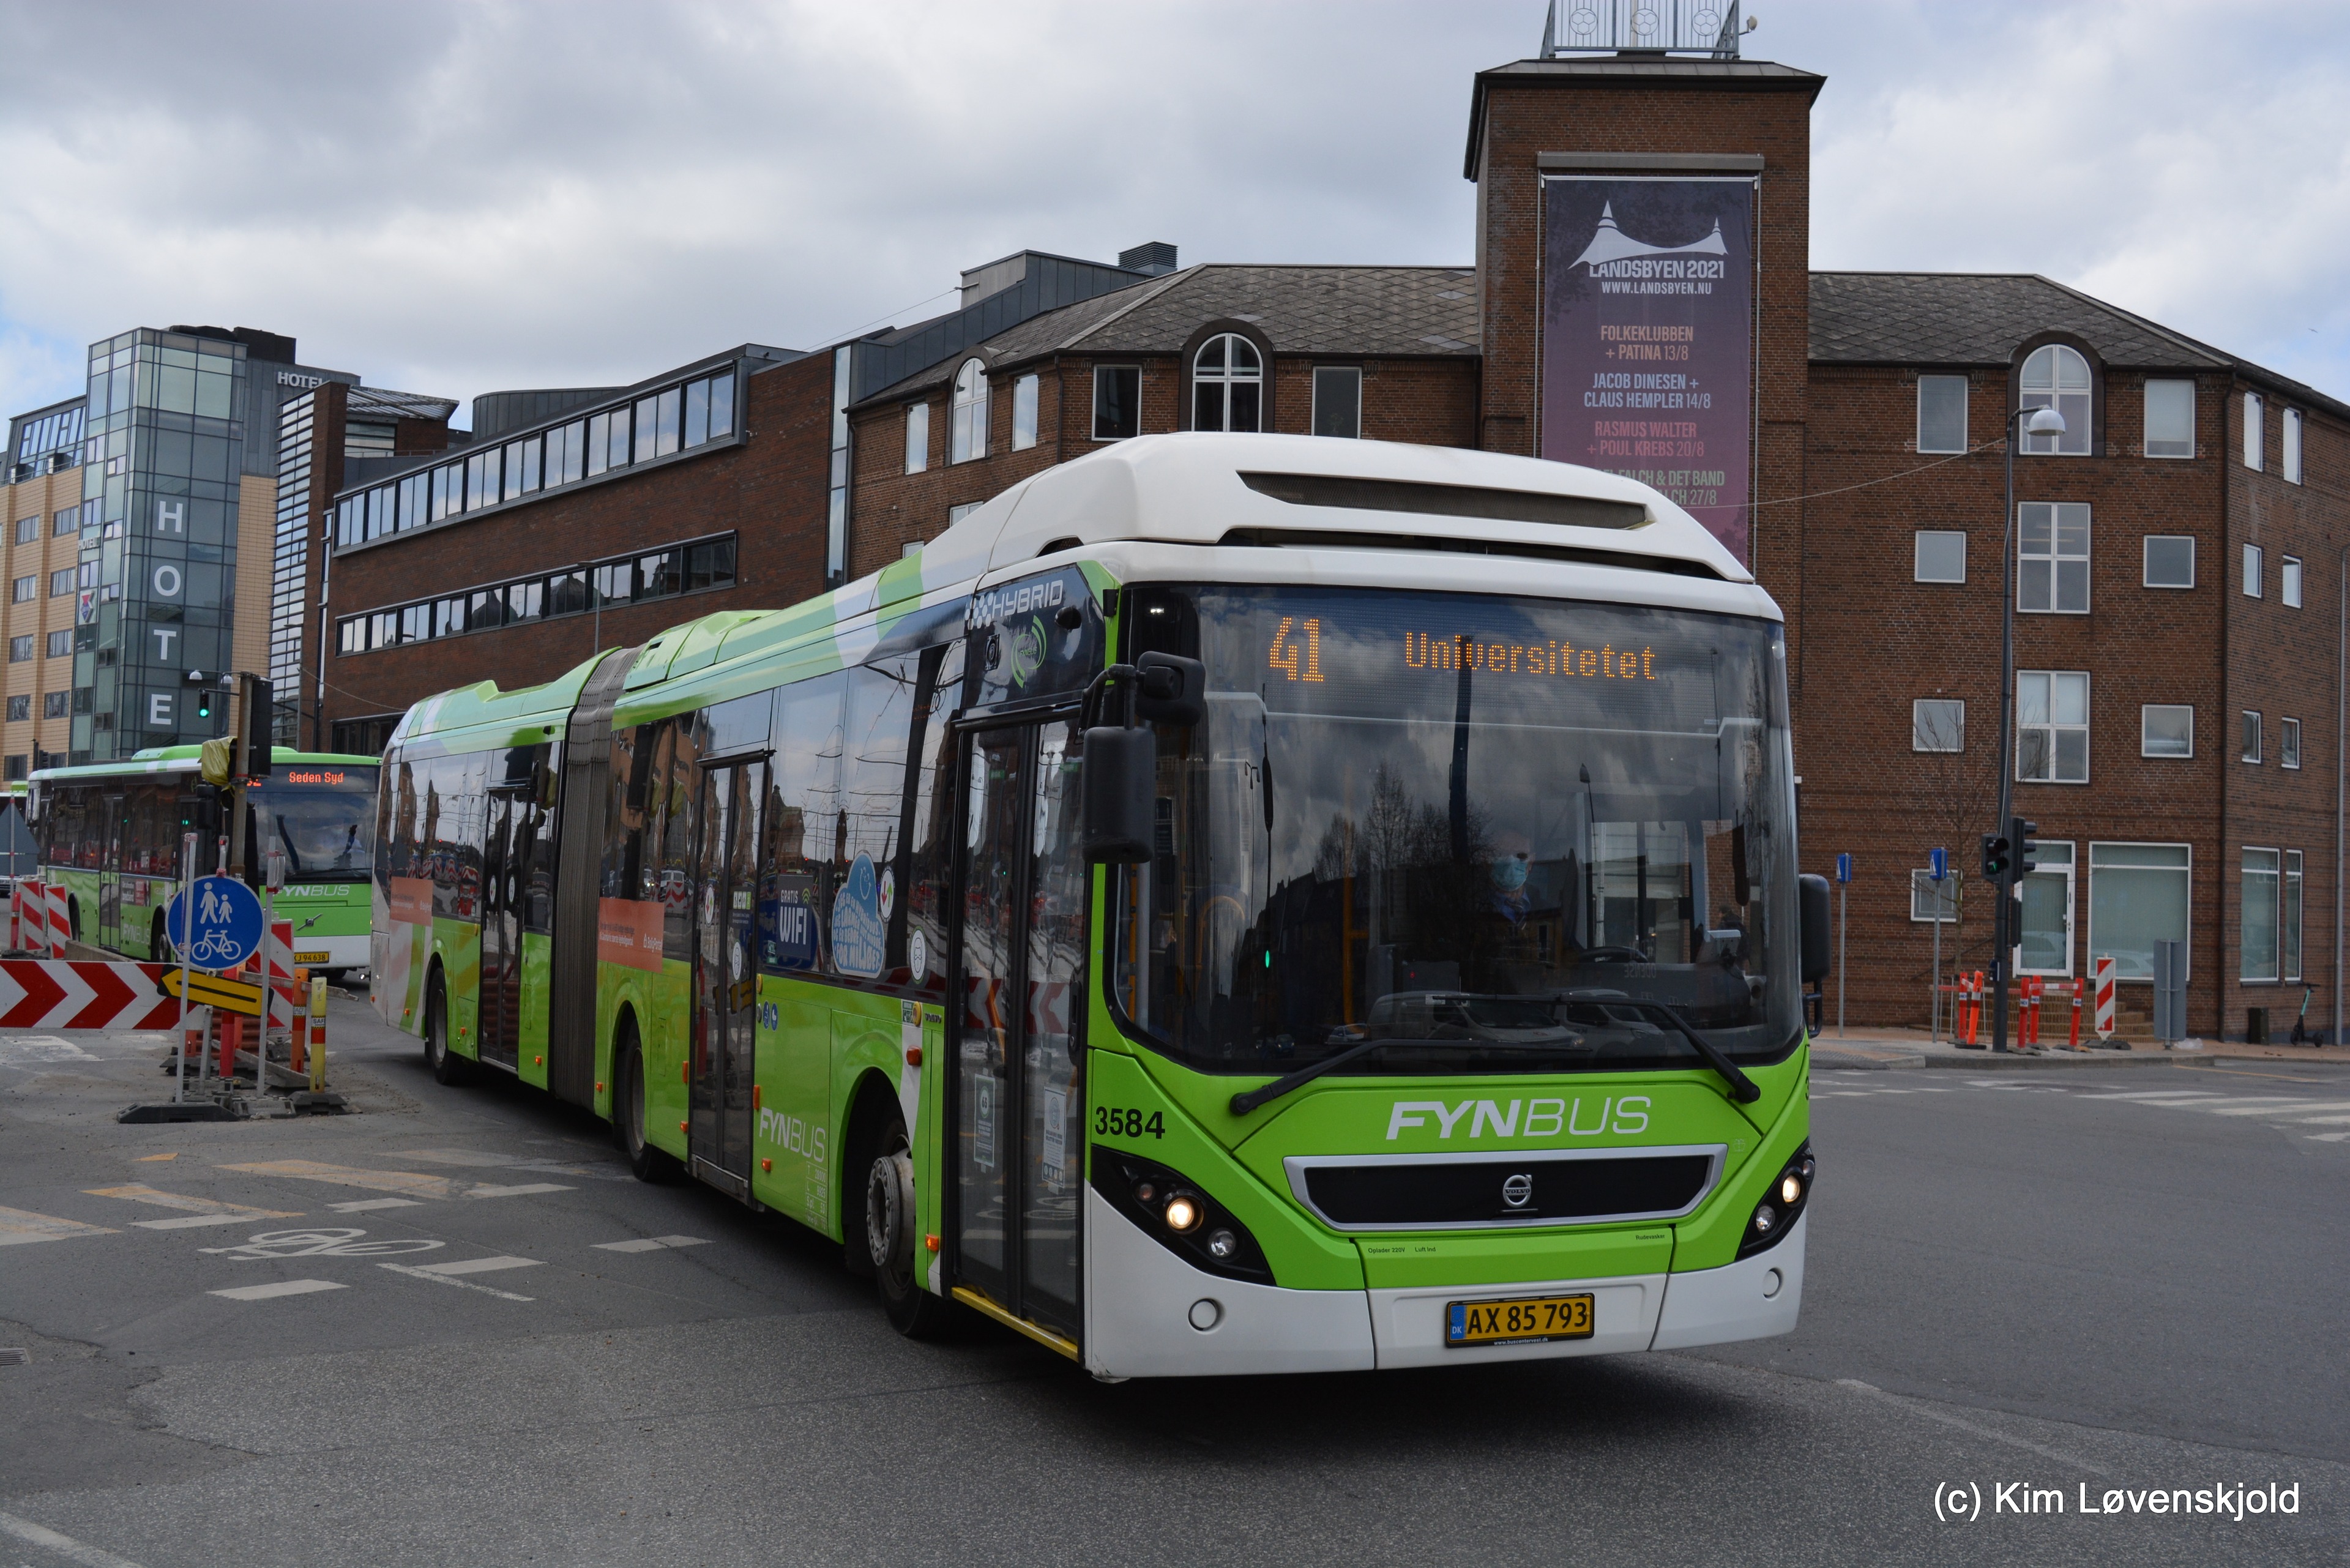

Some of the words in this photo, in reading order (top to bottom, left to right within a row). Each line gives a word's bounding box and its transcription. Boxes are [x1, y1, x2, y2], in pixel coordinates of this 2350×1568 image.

[1589, 259, 1684, 278] LANDSBYEN
[1687, 260, 1725, 278] 2021
[1602, 282, 1712, 294] WWW.LANDSBYEN.NU
[1601, 325, 1693, 341] FOLKEKLUBBEN
[1619, 345, 1662, 360] PATINA
[1664, 345, 1688, 360] 13/8
[1593, 373, 1631, 389] JACOB
[1634, 373, 1686, 389] DINESEN
[1584, 392, 1624, 408] CLAUS
[1626, 393, 1684, 408] HEMPLER
[1686, 394, 1711, 409] 14/8
[1595, 421, 1647, 437] RASMUS
[1649, 422, 1697, 438] WALTER
[1600, 440, 1632, 456] POUL
[1635, 441, 1674, 457] KREBS
[1676, 441, 1704, 457] 20/8
[1656, 470, 1666, 485] &
[1668, 471, 1690, 485] DET
[1693, 471, 1725, 486] BAND
[1690, 490, 1717, 506] 27/8
[992, 580, 1063, 619] HYBRID
[1269, 616, 1324, 682] 41
[1406, 632, 1655, 679] Universitetet
[289, 772, 321, 783] Seden
[324, 772, 344, 785] Syd
[780, 889, 799, 904] GRATIS
[123, 924, 151, 944] FYNBUS
[780, 906, 807, 945] WIFI
[1095, 1106, 1166, 1139] 3584
[1386, 1096, 1651, 1140] FYNBUS
[759, 1107, 826, 1163] FYNBUS
[1452, 1325, 1462, 1335] DK
[1467, 1307, 1501, 1335] AX
[1507, 1305, 1537, 1332] 85
[1543, 1302, 1587, 1329] 793
[1494, 1337, 1548, 1346] www.buscentervest.dk
